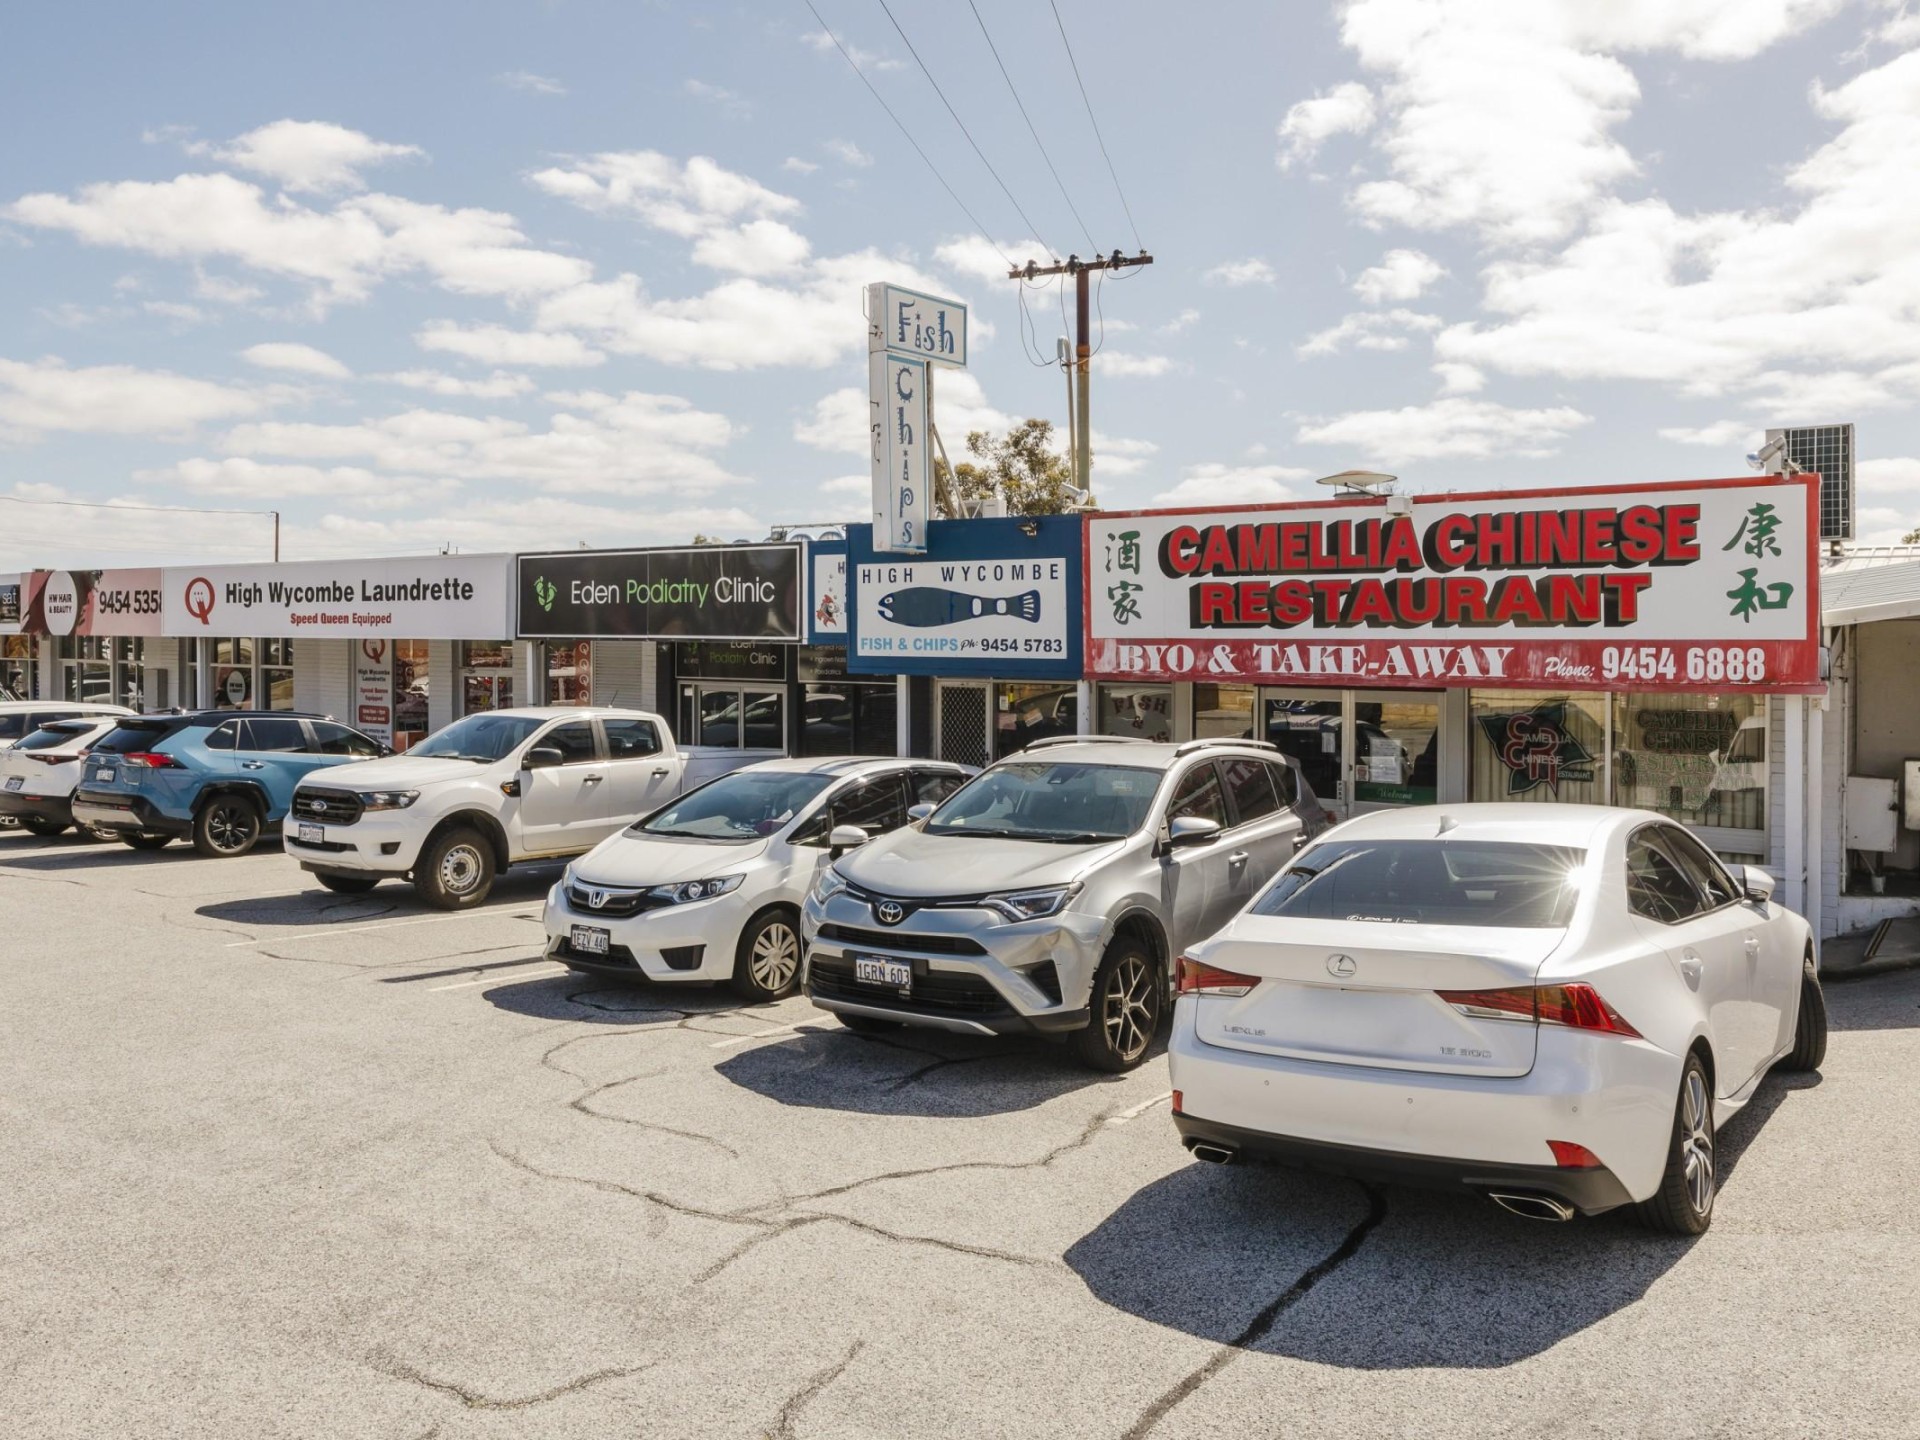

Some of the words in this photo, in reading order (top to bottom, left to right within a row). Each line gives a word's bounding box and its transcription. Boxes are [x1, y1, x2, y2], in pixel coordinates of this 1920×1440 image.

[898, 299, 954, 354] Fish
[896, 367, 914, 543] Chips
[1159, 517, 1424, 579] CAMELLIA
[1424, 503, 1701, 572] CHINESE
[863, 568, 913, 584] HIGH
[941, 563, 1059, 582] WYCOMBE
[1105, 530, 1144, 625] 酒家
[1722, 502, 1795, 623] 康和
[59, 594, 72, 603] HAIR
[99, 590, 131, 614] 9454
[133, 590, 162, 614] 535
[226, 582, 262, 608] High
[269, 580, 354, 608] Wycombe
[362, 578, 473, 602] Laundrette
[571, 580, 619, 604] Eden
[626, 578, 708, 608] Podiatry
[715, 576, 775, 603] Clinic
[1190, 572, 1653, 629] RESTAURANT
[290, 612, 318, 626] Speed
[321, 613, 349, 625] Queen
[352, 612, 391, 626] Equipped
[749, 652, 777, 665] Clinic
[861, 637, 894, 651] FISH
[897, 638, 908, 651] &
[913, 638, 958, 652] CHIPS
[981, 638, 1019, 652] 9454
[1024, 638, 1063, 653] 5783
[1119, 644, 1194, 673] BYO
[1208, 645, 1241, 674] &
[1253, 643, 1514, 679] TAKE-AWAY
[1545, 656, 1594, 678] Phone:
[1602, 647, 1676, 680] 9454
[1687, 647, 1765, 681] 6888
[1637, 710, 1739, 731] CAMELLIA
[1644, 731, 1732, 751] CHINESE
[1620, 752, 1753, 774] RESTAURANT
